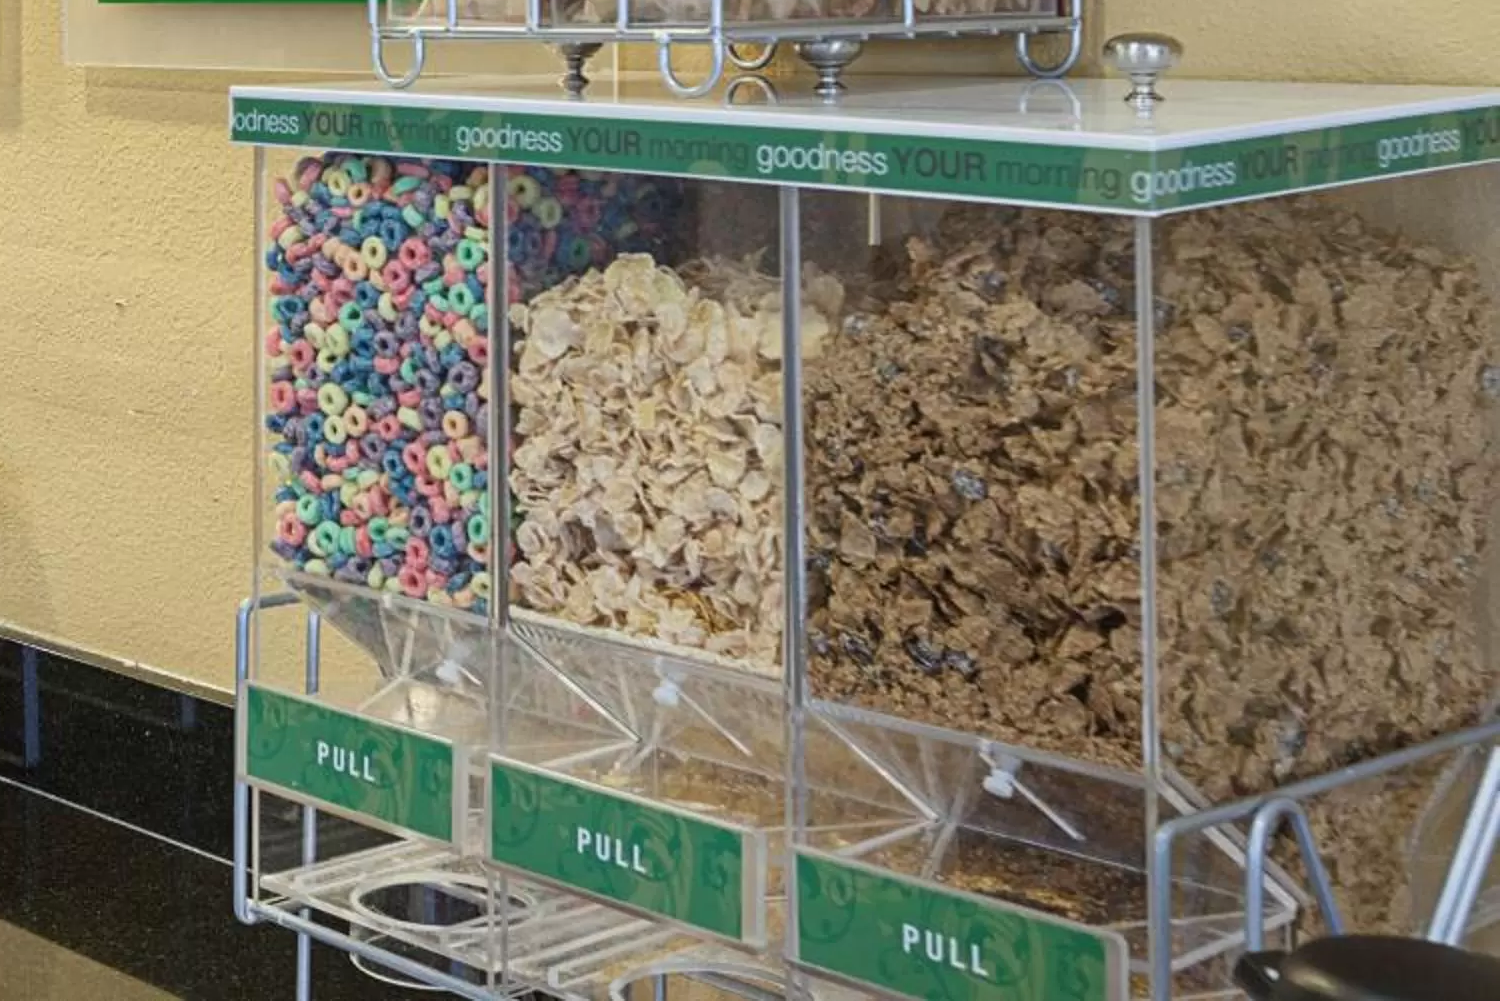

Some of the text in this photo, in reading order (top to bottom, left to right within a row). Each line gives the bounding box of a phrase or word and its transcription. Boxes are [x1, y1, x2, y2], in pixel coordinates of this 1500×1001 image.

[232, 107, 299, 135] odness
[302, 109, 364, 137] YOUR
[456, 123, 564, 153] goodness
[567, 126, 641, 156] YOUR
[756, 142, 889, 176] goodness
[891, 146, 988, 182] YOUR
[995, 159, 1122, 200] morning
[1130, 160, 1236, 203] goodness
[1377, 127, 1461, 168] goodness
[316, 739, 376, 782] PULL
[576, 826, 647, 874] PULL
[902, 922, 989, 977] PULL
